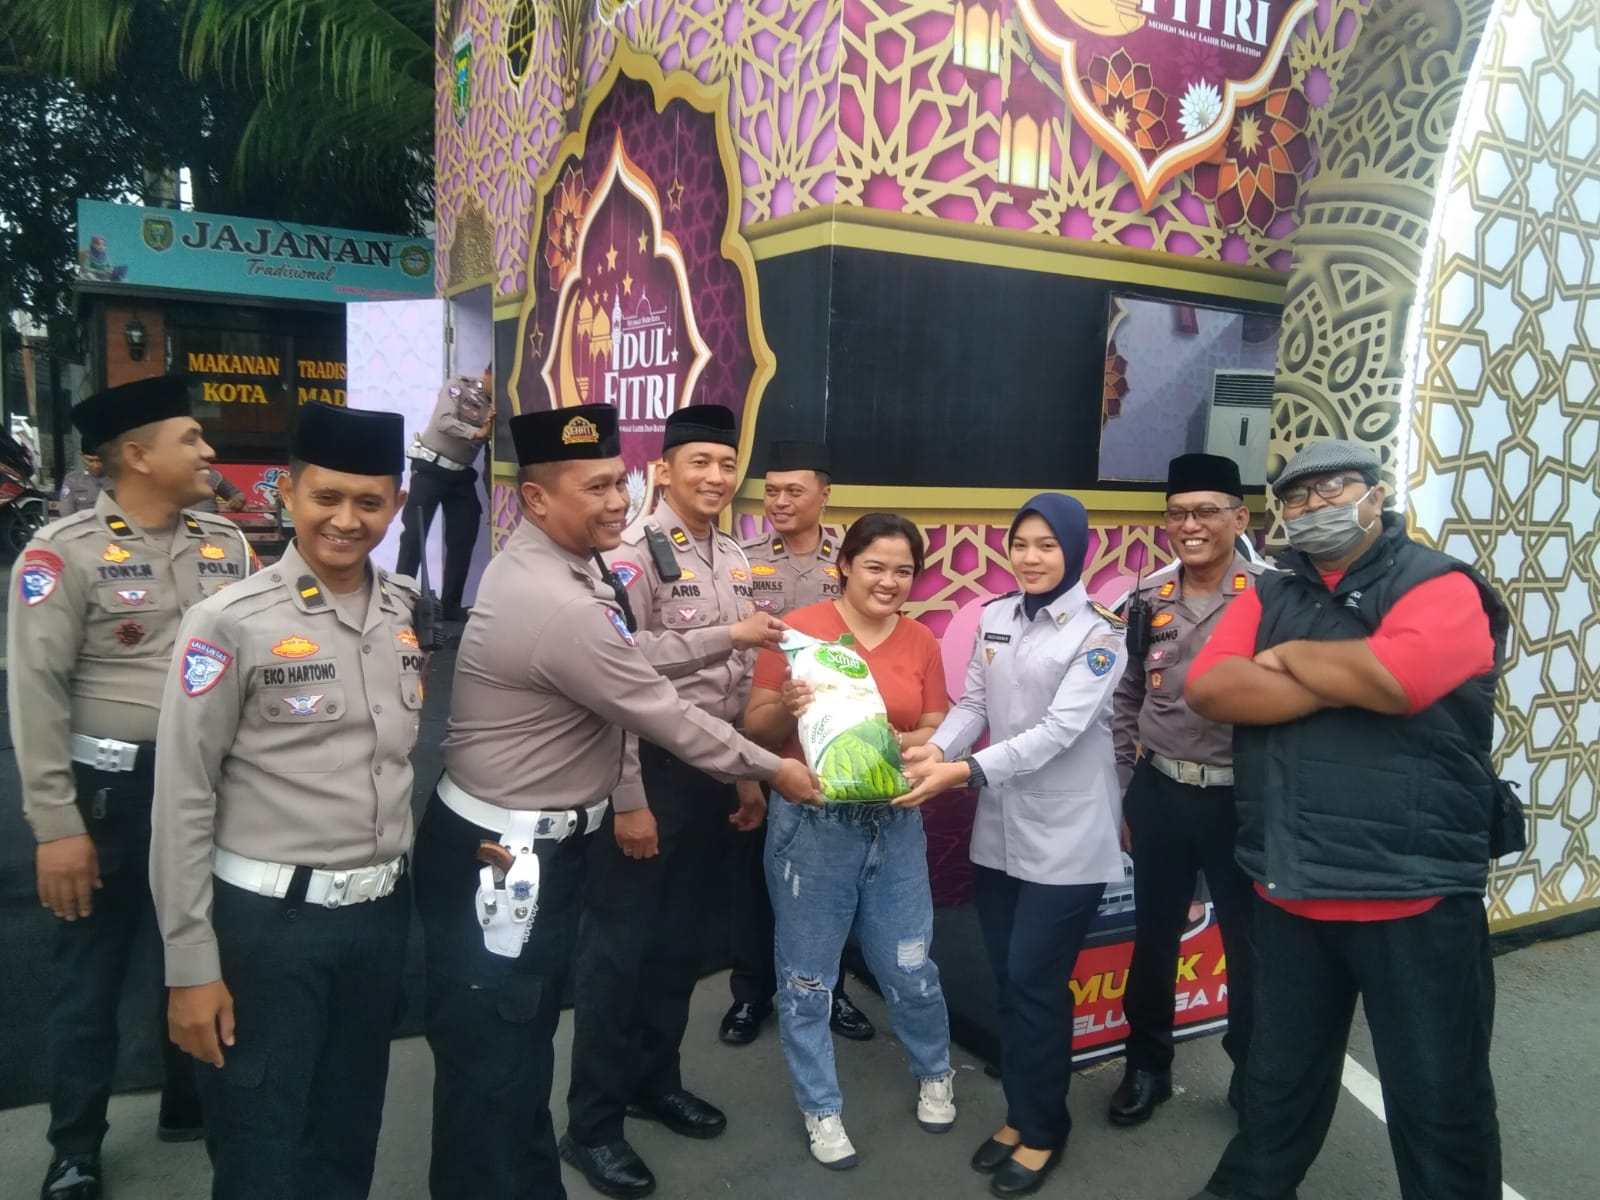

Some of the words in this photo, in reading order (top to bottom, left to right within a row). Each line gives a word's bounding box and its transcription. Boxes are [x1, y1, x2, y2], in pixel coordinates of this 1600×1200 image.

[182, 220, 393, 267] JAJANAN
[247, 258, 337, 282] Tradisional
[612, 327, 670, 371] IDUL
[188, 352, 280, 376] MAKANAN
[202, 382, 269, 404] KOTA
[604, 371, 677, 420] FITRI
[197, 561, 240, 576] POLRI
[671, 584, 701, 598] ARIS
[264, 667, 285, 685] EKO
[288, 663, 336, 683] HARTONO
